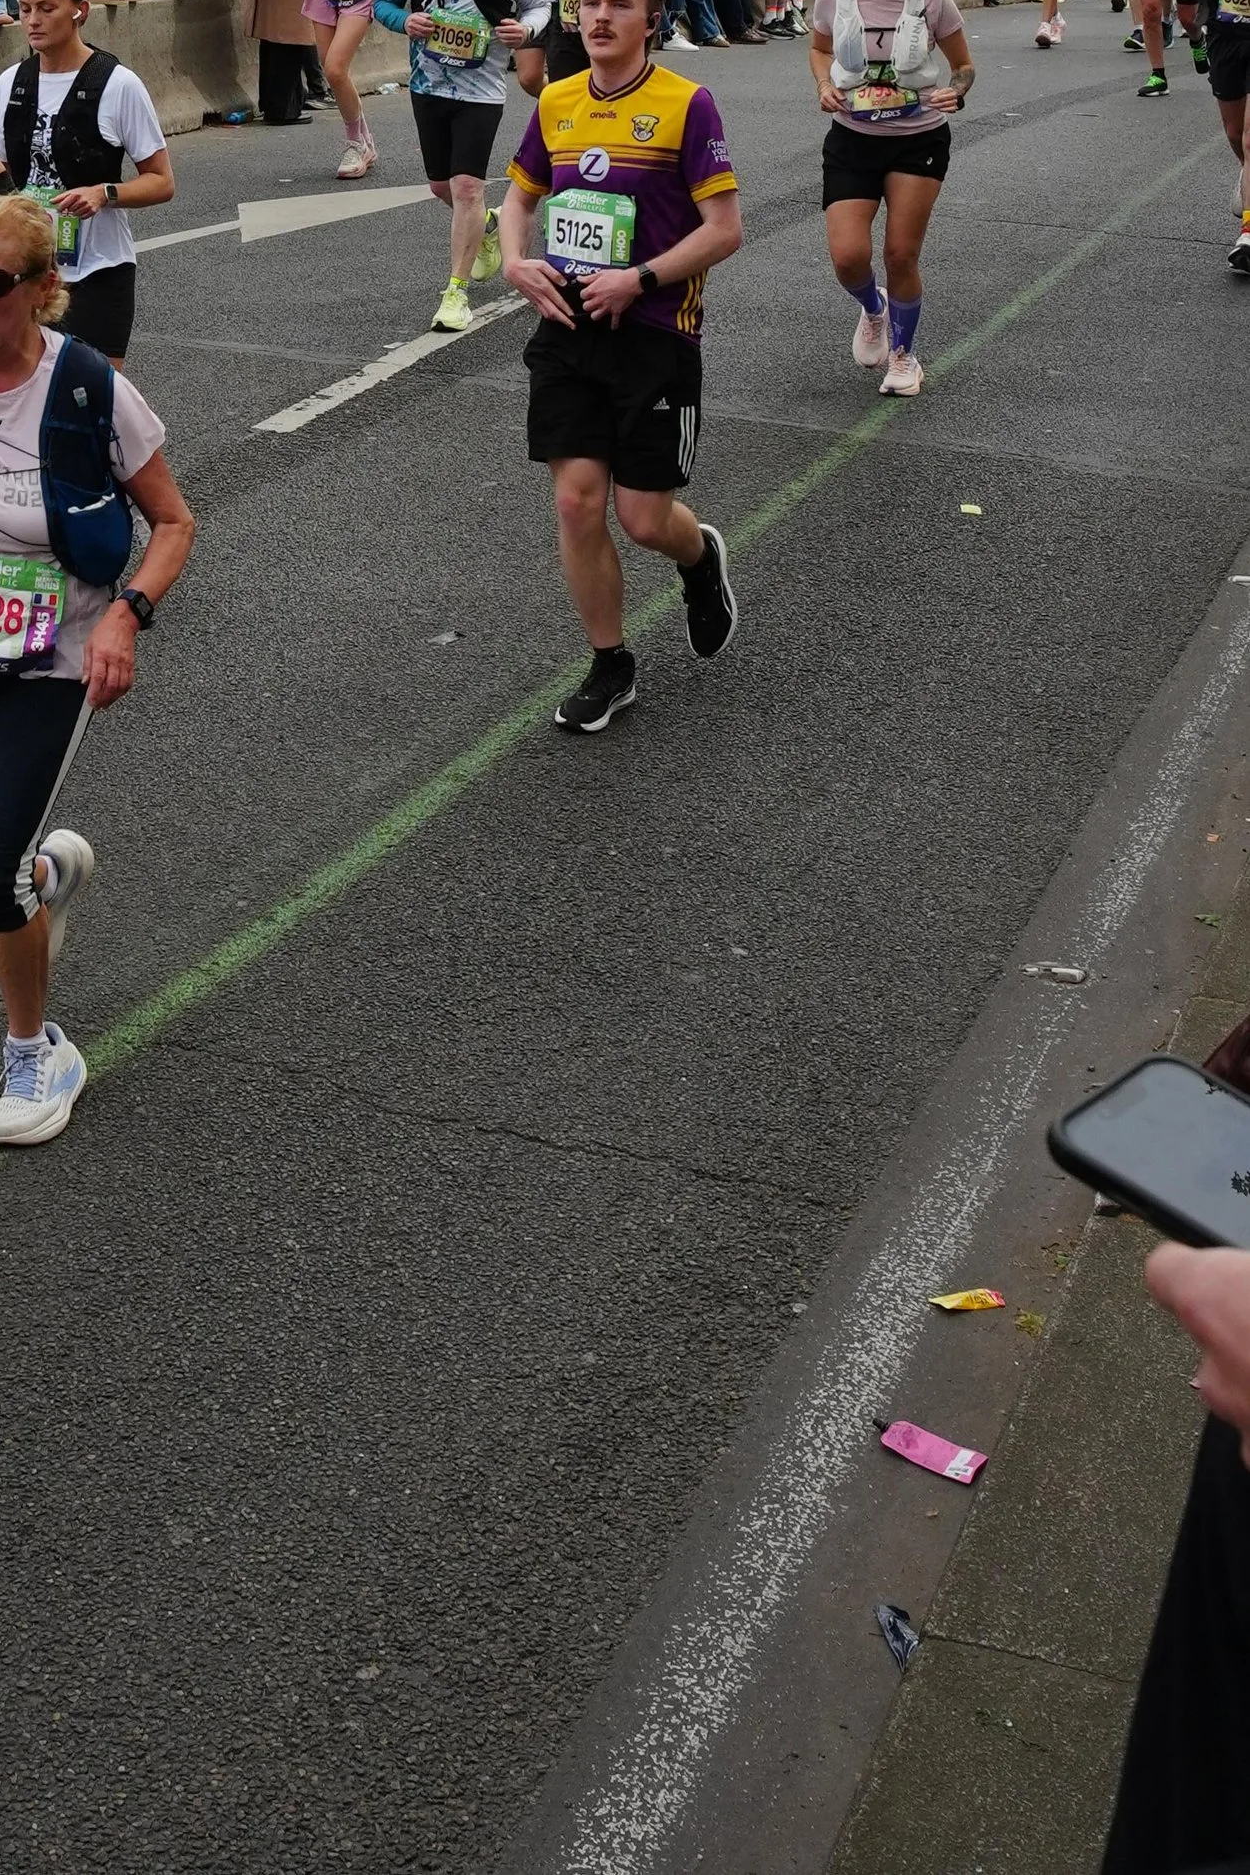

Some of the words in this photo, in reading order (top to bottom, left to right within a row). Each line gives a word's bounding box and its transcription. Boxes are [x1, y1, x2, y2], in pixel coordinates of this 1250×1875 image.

[432, 24, 473, 48] 51069
[555, 217, 604, 251] 51125
[3, 487, 43, 508] 202
[30, 611, 51, 652] 3H45
